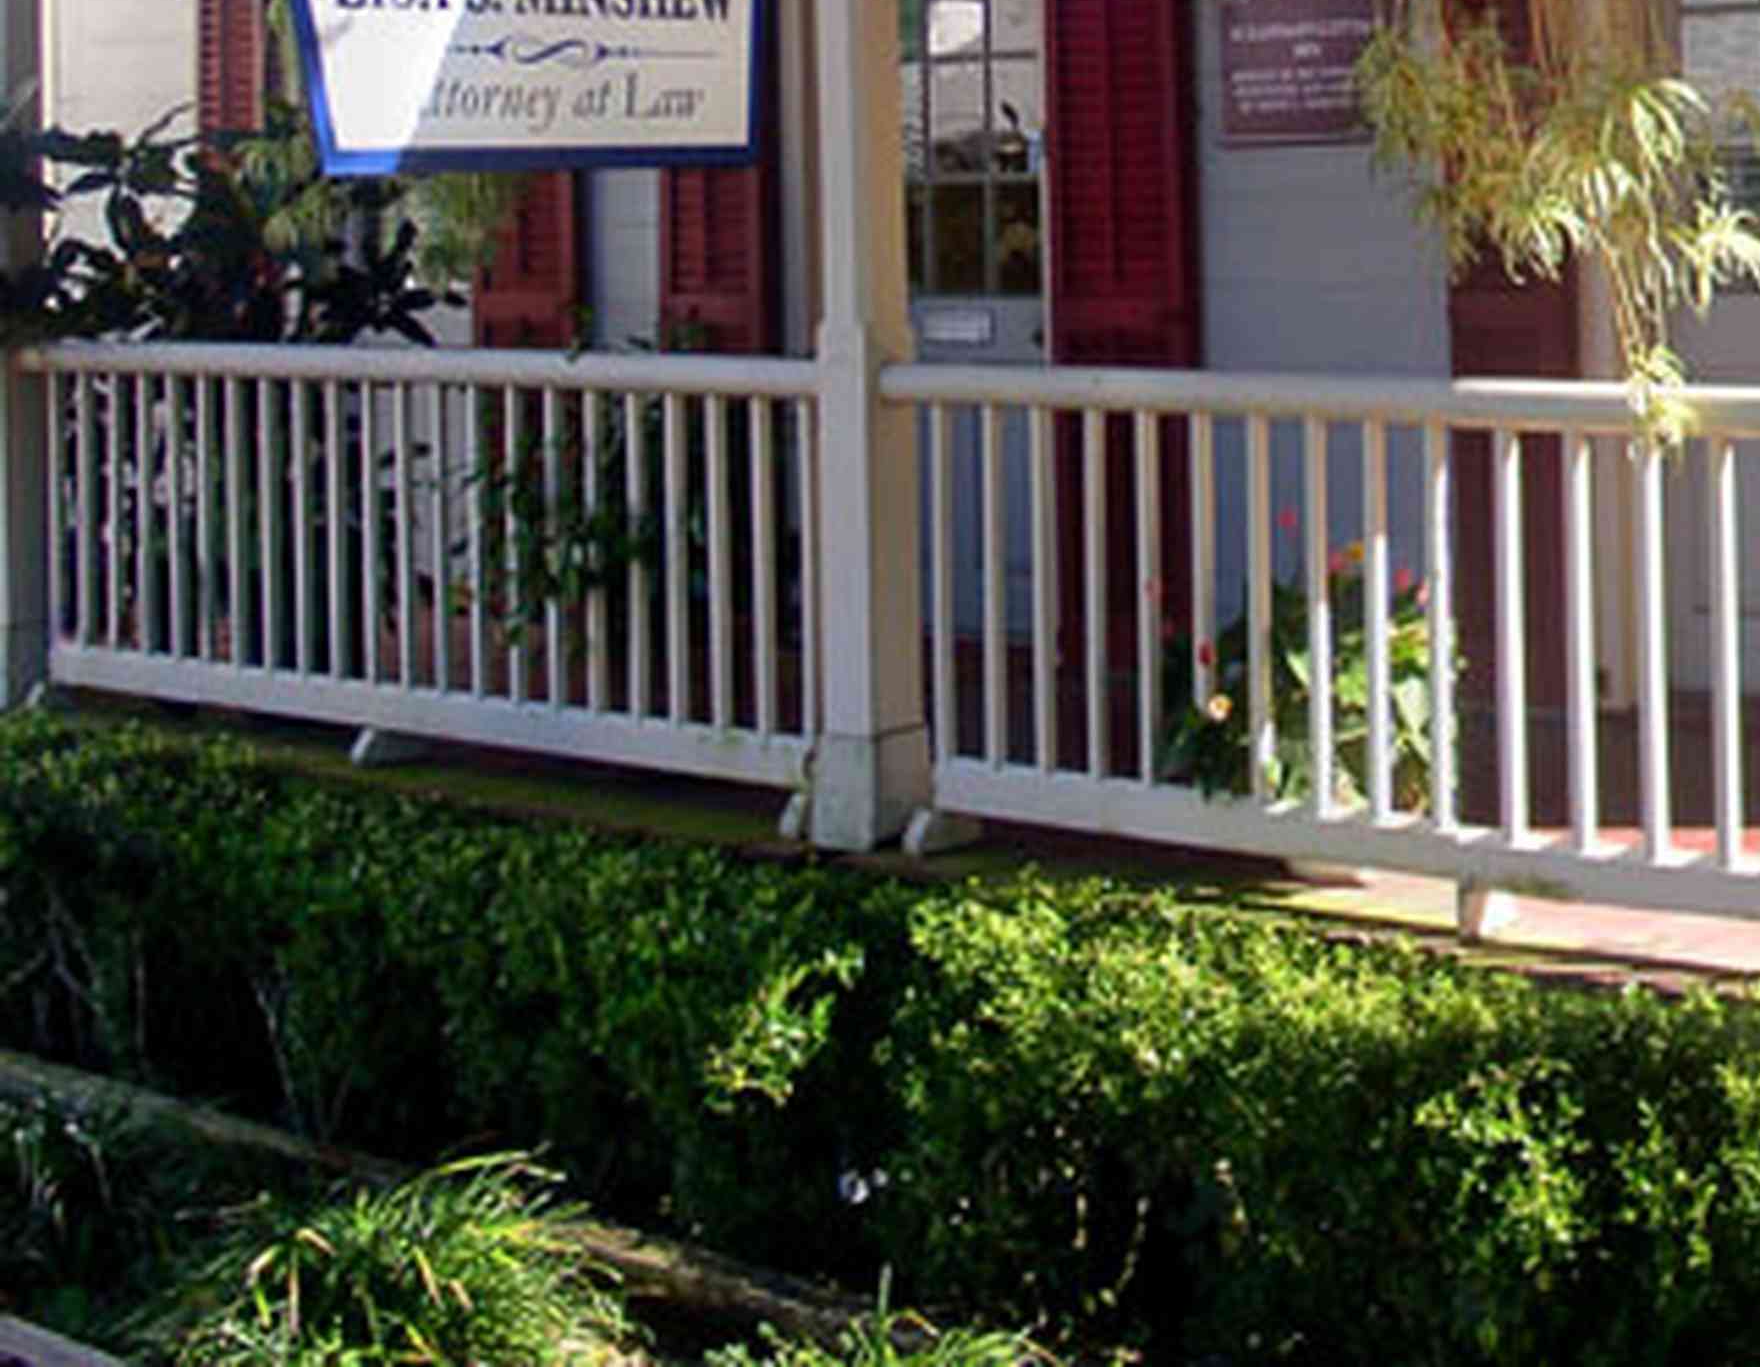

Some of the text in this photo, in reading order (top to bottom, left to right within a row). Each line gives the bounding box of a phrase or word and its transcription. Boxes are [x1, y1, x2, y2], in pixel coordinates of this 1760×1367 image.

[412, 71, 704, 134] ttorney at Law
